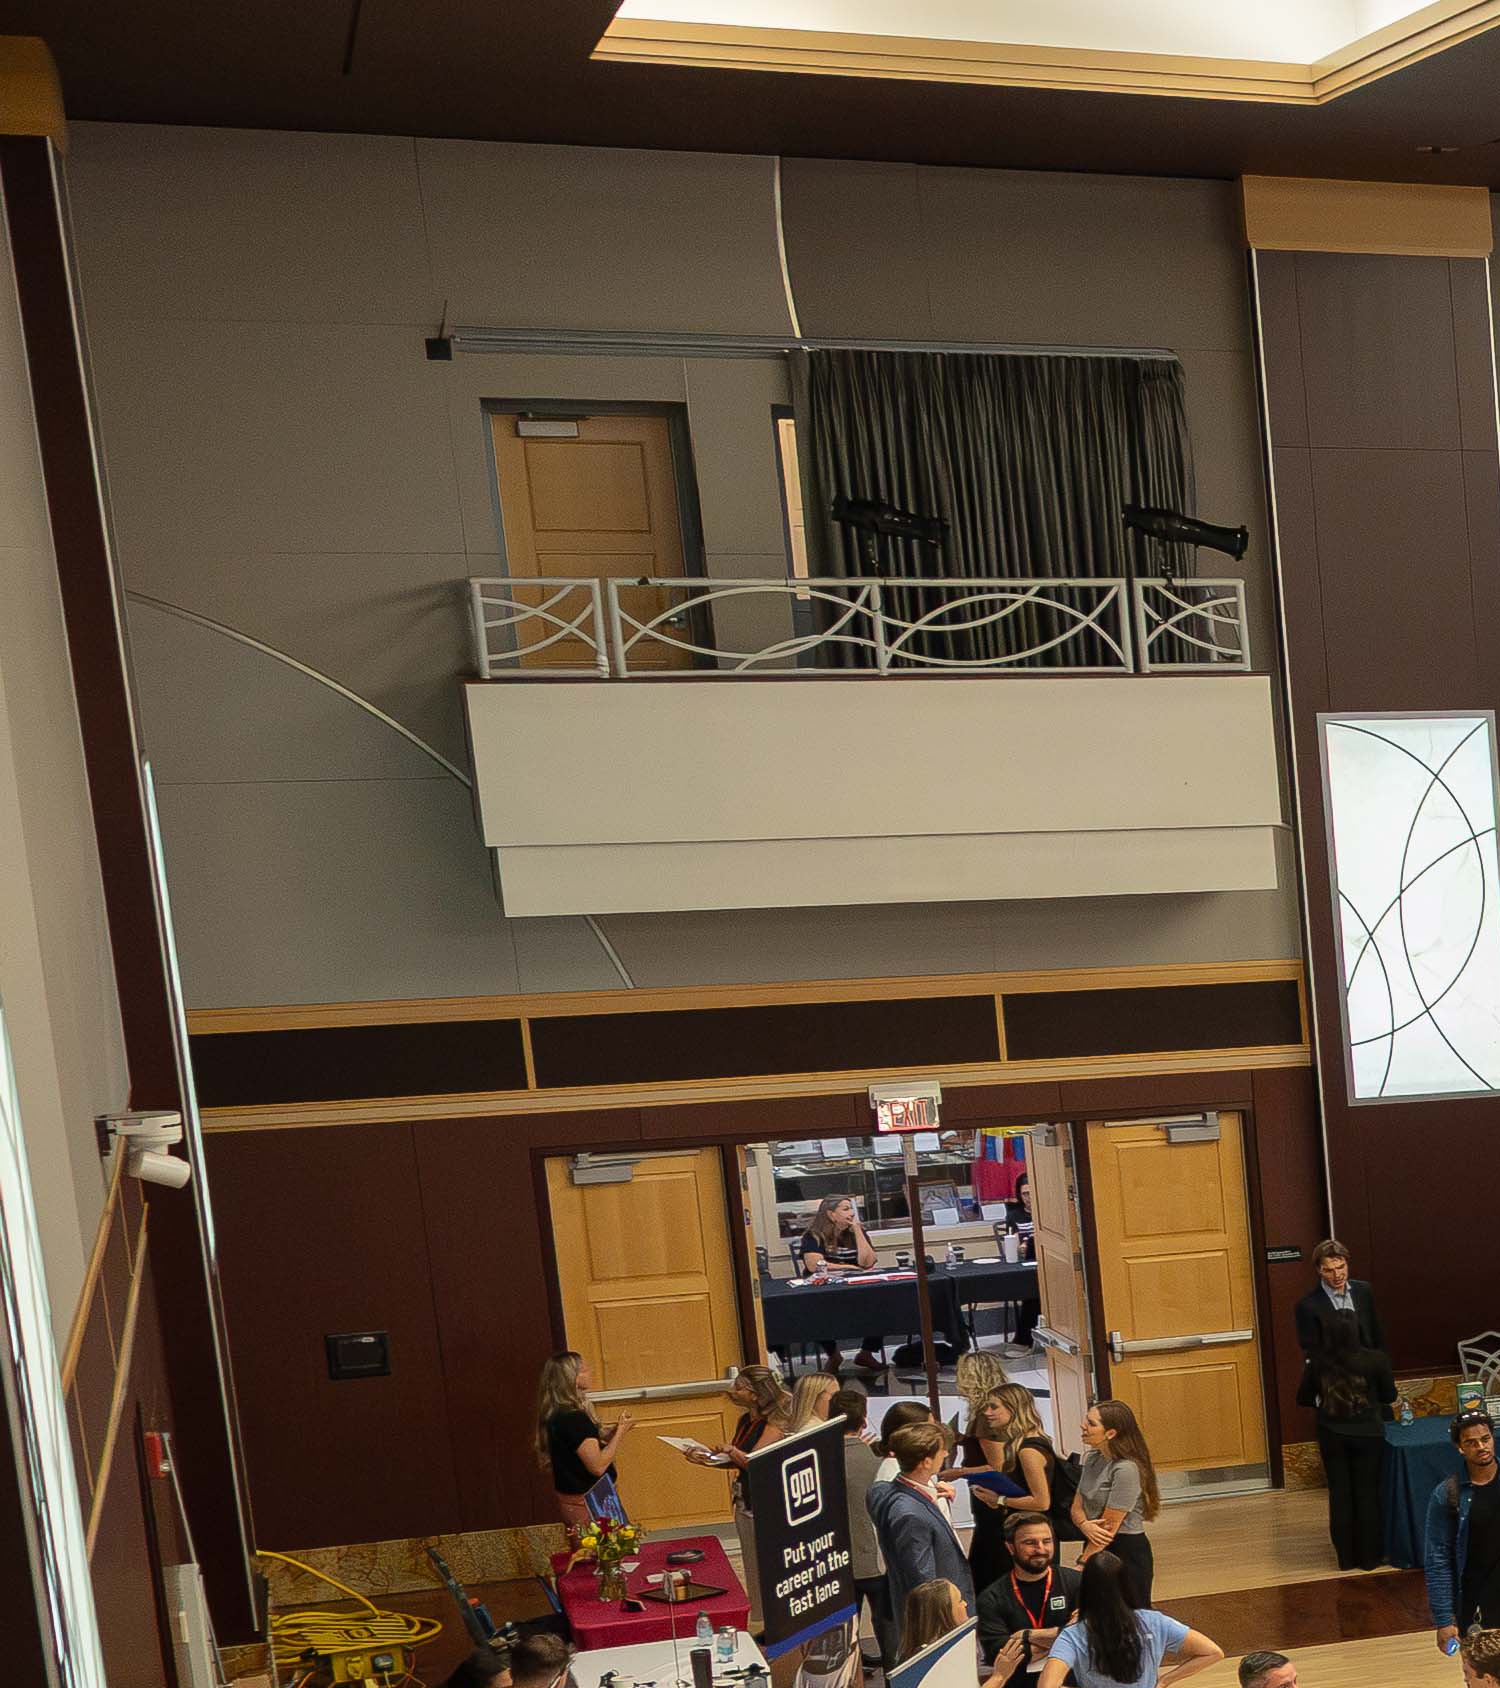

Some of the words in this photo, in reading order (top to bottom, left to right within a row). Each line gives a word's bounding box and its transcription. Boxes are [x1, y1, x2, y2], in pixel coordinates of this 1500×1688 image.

[890, 1100, 929, 1128] EXIT
[789, 1466, 816, 1508] gm
[784, 1541, 806, 1569] Put
[808, 1531, 835, 1561] your
[776, 1567, 813, 1598] career
[816, 1560, 827, 1577] in
[829, 1551, 849, 1571] the
[789, 1593, 814, 1617] fast
[815, 1579, 840, 1605] lane
